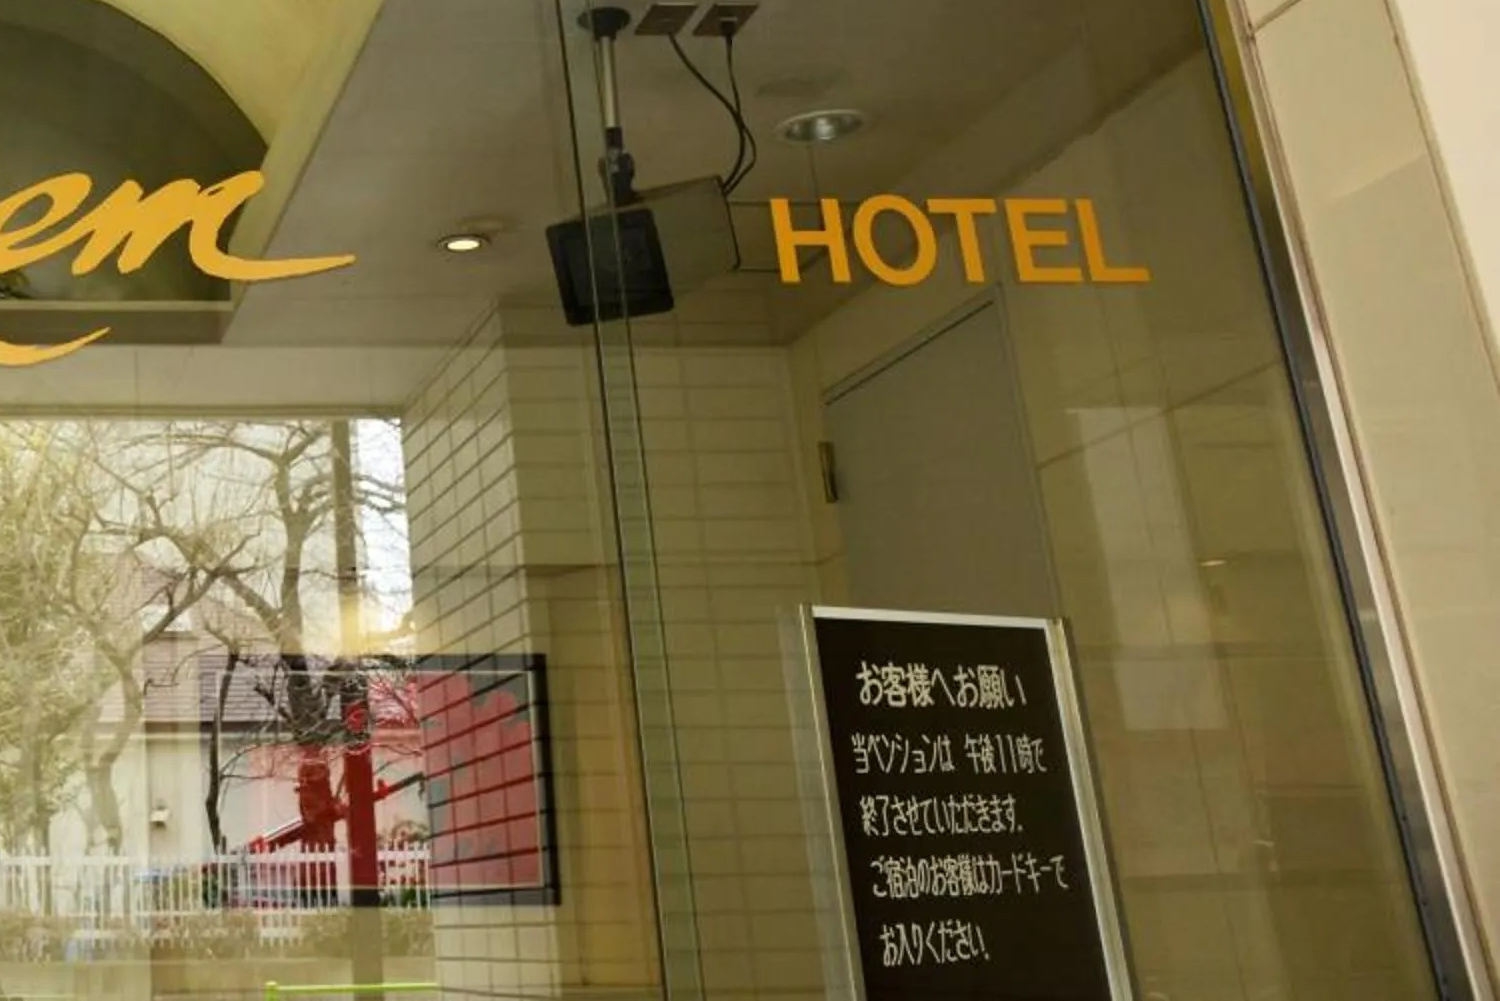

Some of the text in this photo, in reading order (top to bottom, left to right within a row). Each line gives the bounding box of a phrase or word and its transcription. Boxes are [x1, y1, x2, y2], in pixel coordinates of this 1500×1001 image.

[771, 194, 1151, 286] HOTEL
[856, 661, 1027, 709] お客様へお願い
[851, 733, 1047, 774] 当ペンションは 午後11時で
[871, 852, 1069, 899] ご宿泊のお客様はカードキーで
